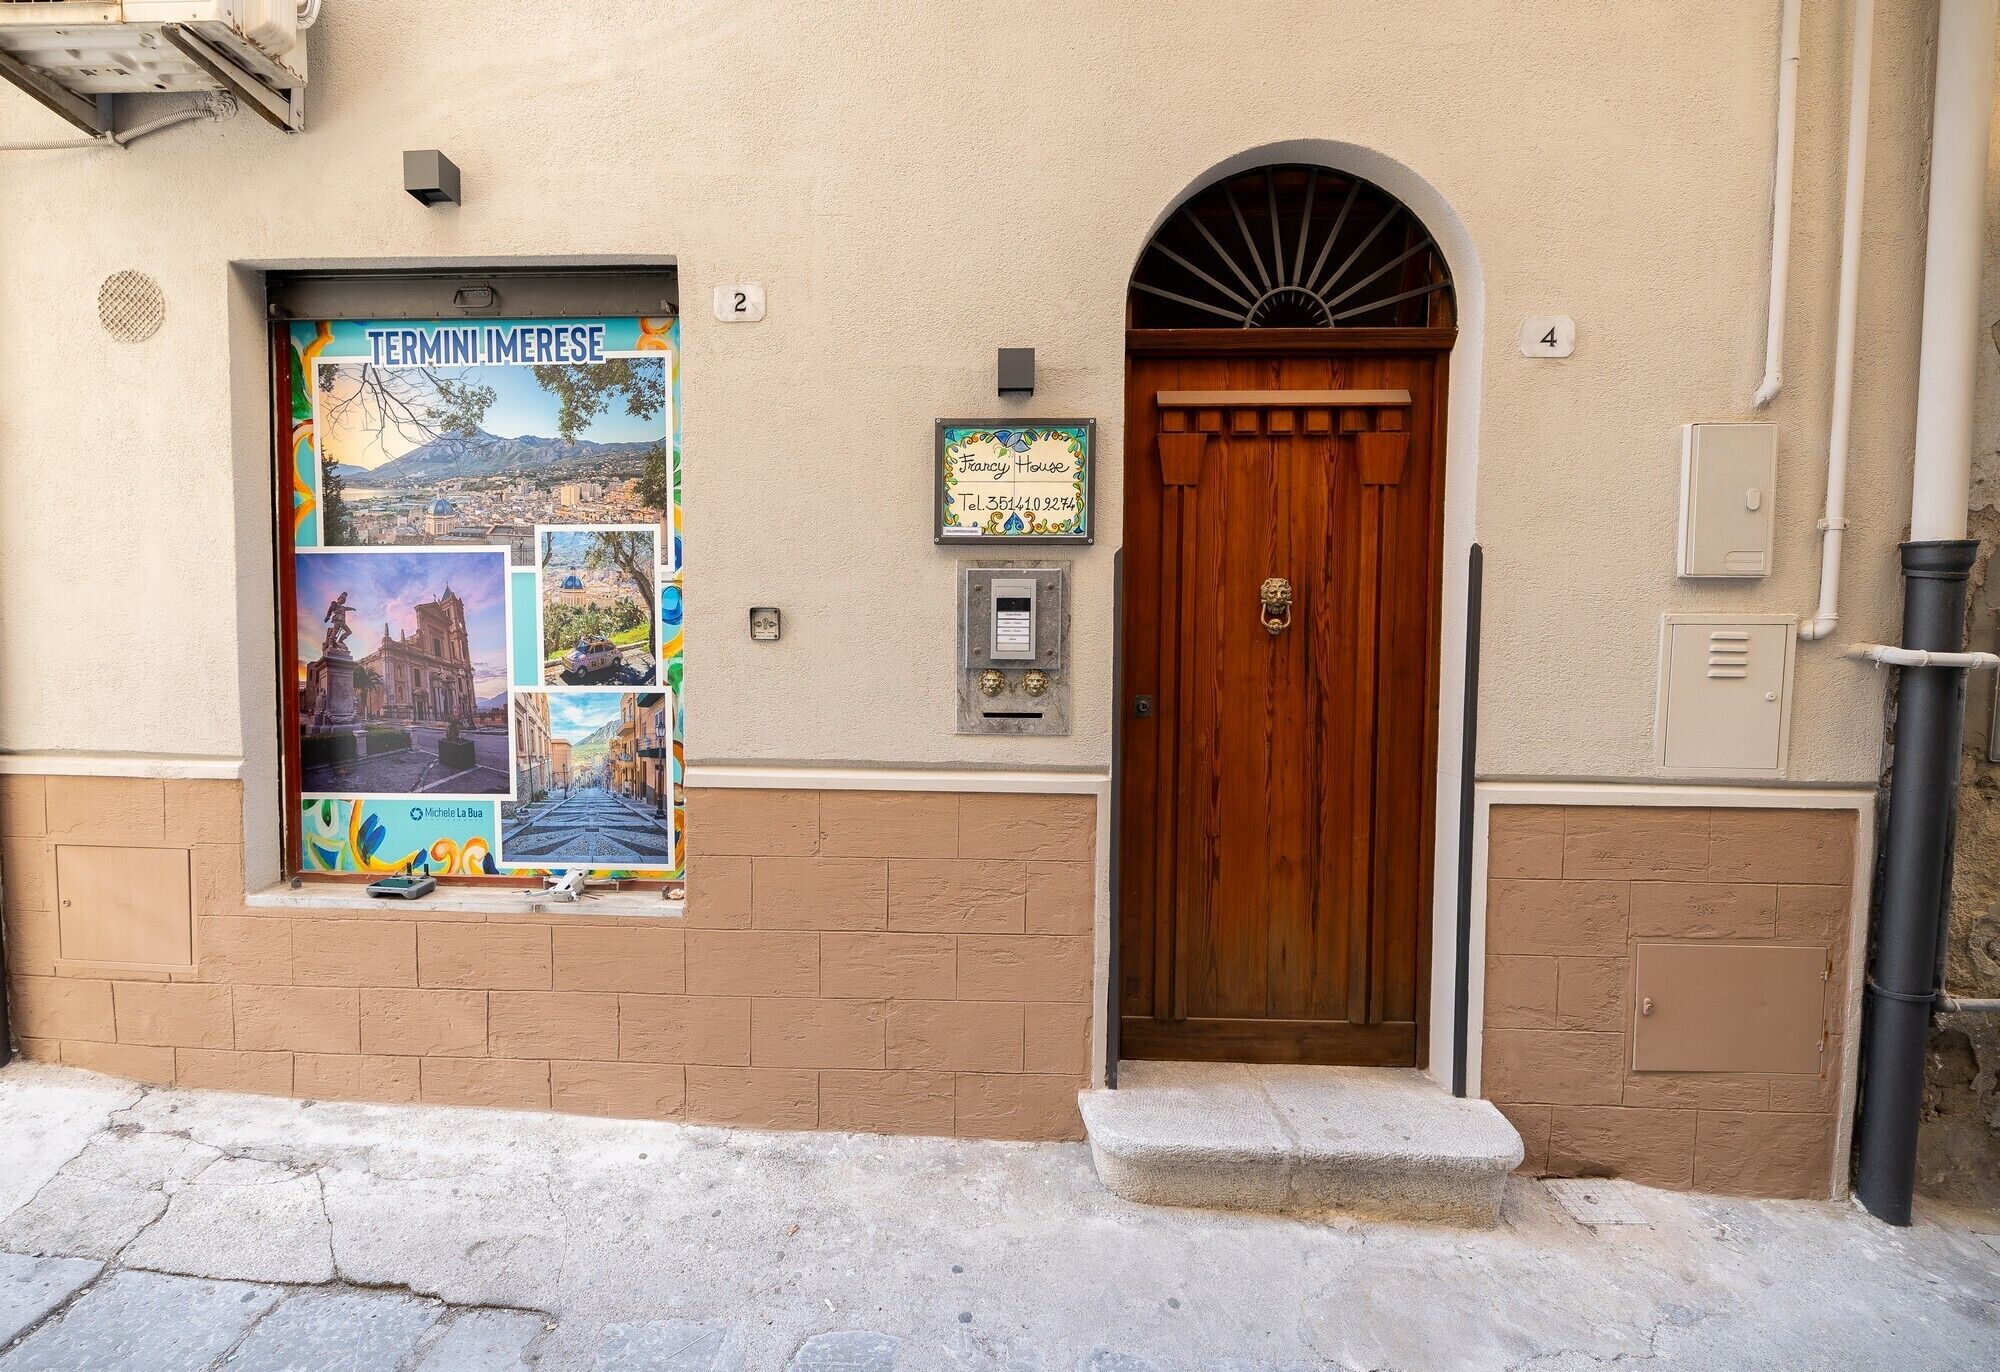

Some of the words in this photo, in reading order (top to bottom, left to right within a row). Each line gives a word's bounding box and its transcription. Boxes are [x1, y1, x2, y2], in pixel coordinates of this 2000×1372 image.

[734, 292, 747, 312] 2
[367, 328, 478, 366] TERMINI
[486, 326, 604, 364] IMERESE
[1540, 326, 1557, 348] 4
[958, 453, 1011, 480] Francy
[1015, 454, 1070, 474] House
[425, 807, 456, 818] Michele
[456, 807, 467, 818] La
[468, 807, 483, 818] Bua
